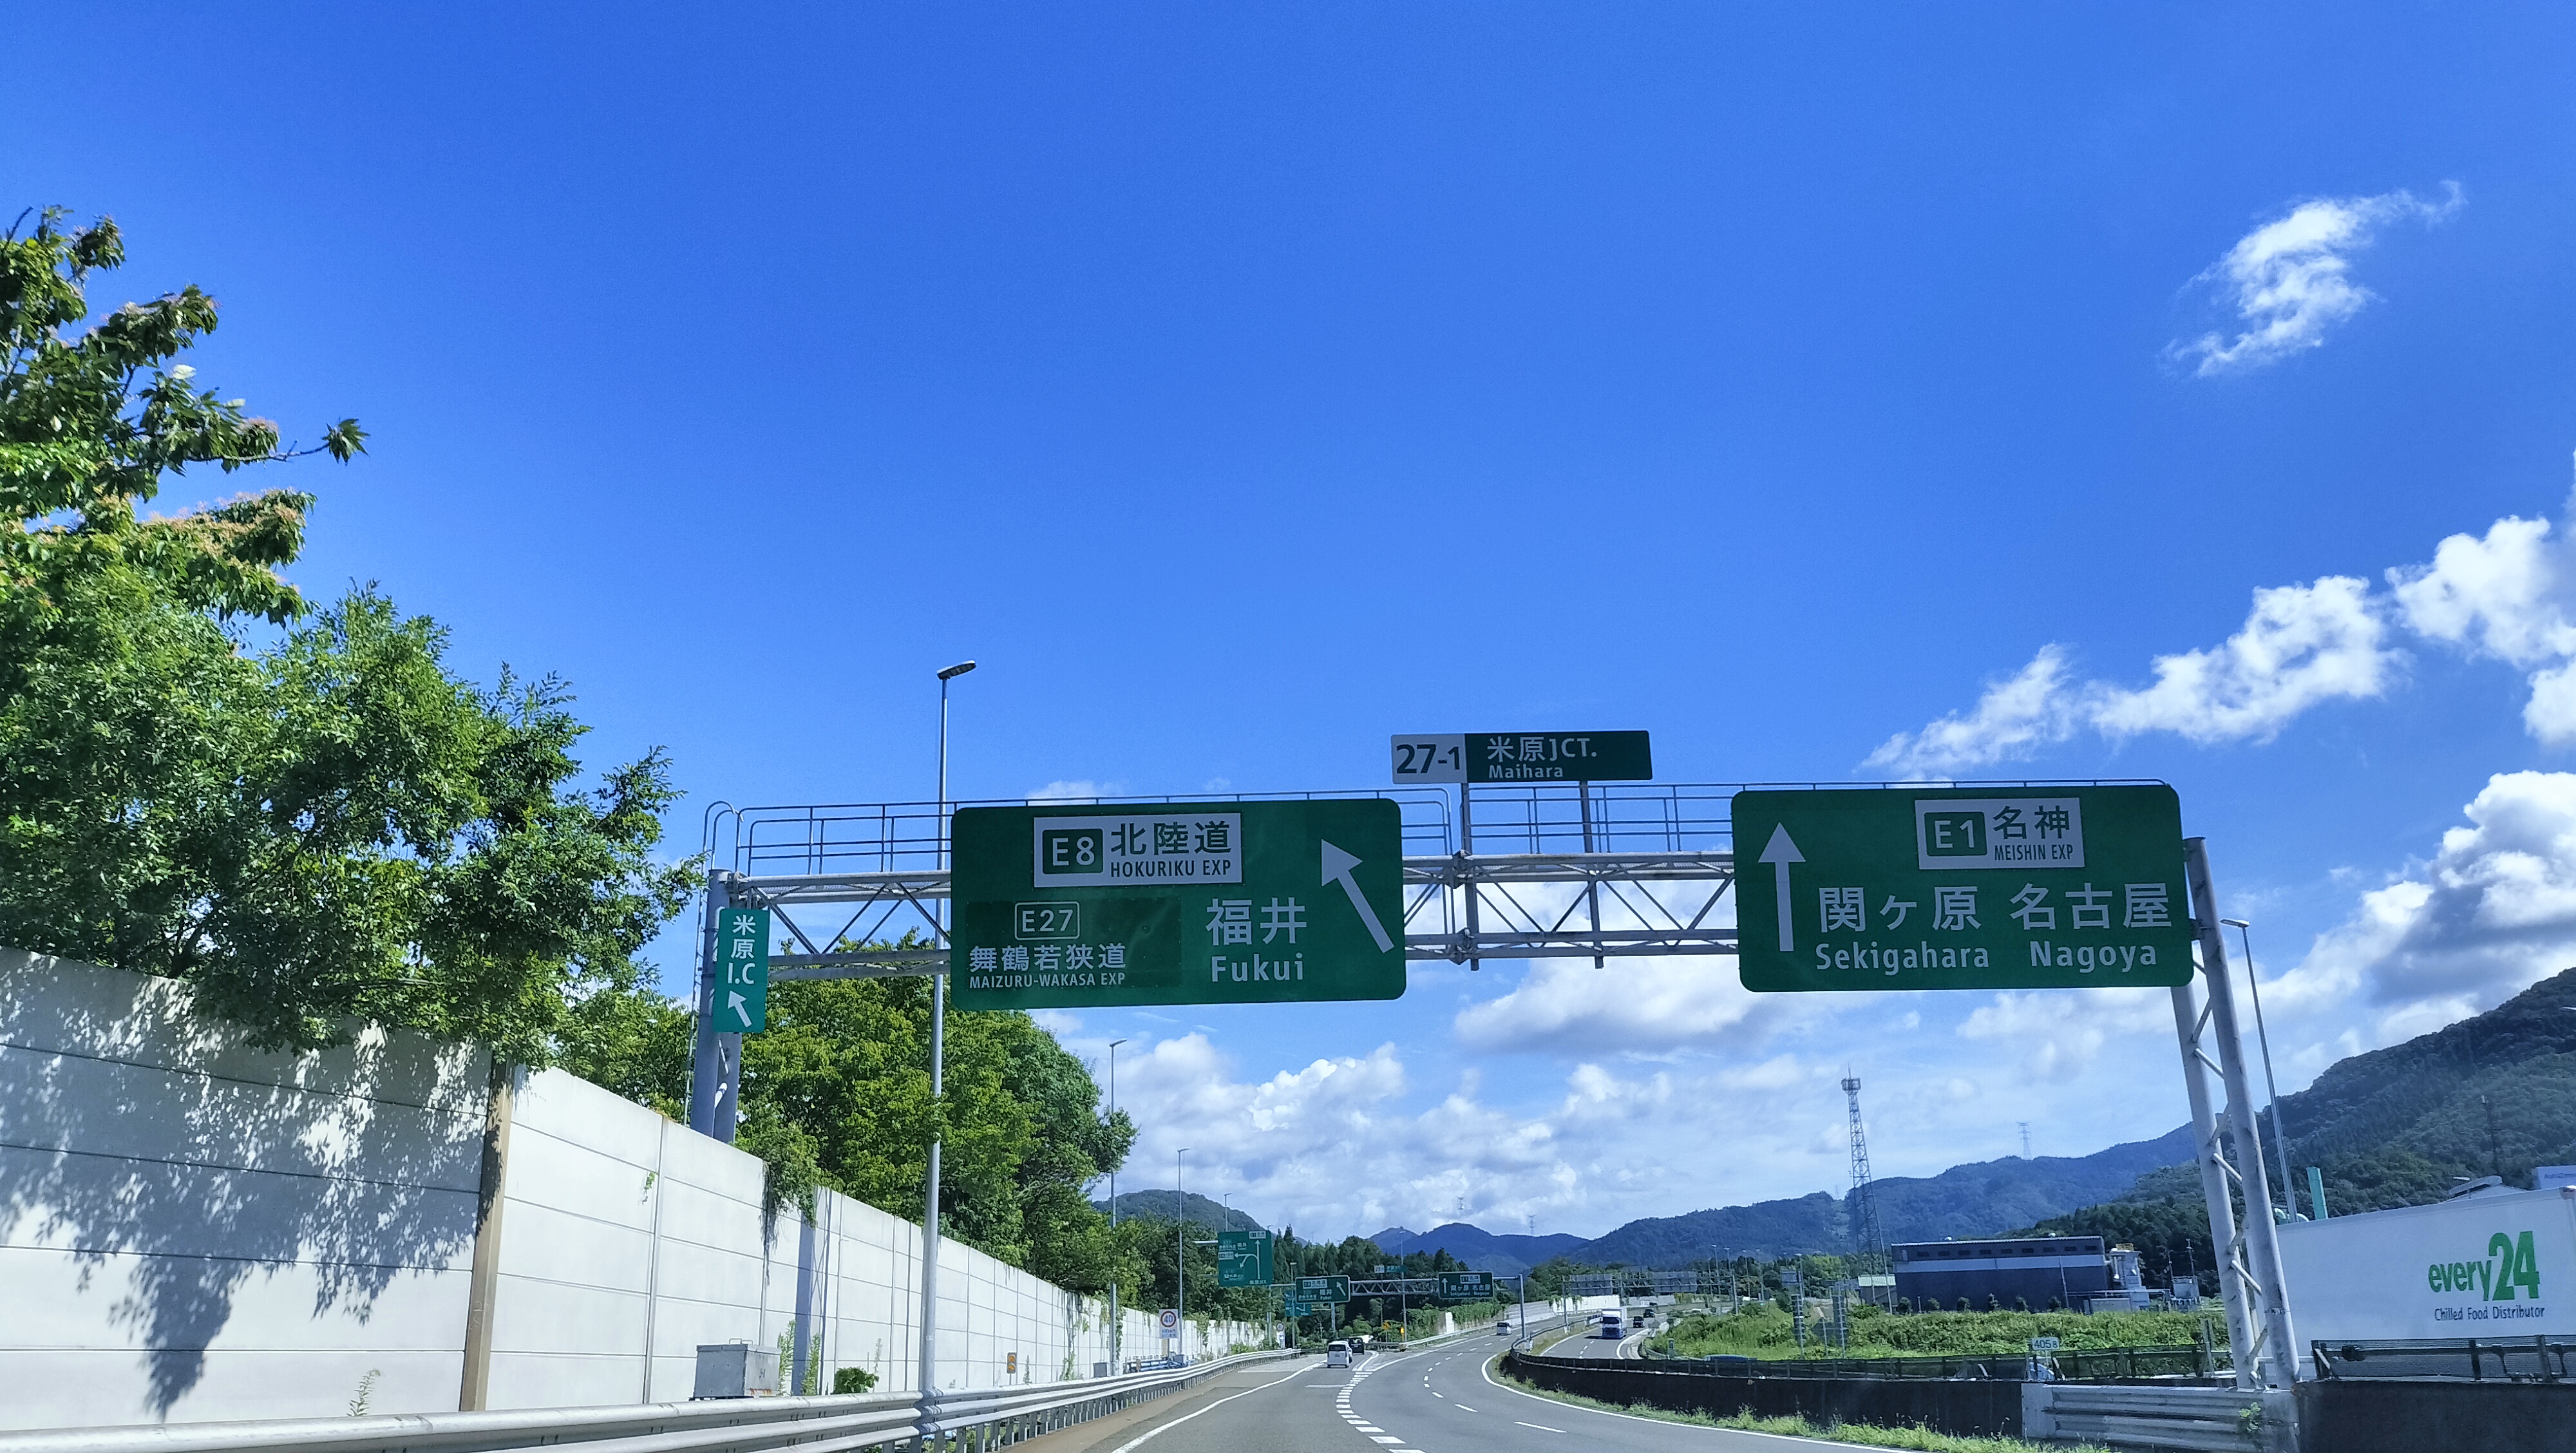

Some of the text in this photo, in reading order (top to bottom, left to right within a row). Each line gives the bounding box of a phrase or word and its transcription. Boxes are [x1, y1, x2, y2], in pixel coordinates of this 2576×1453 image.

[1396, 744, 1461, 774] 27-1
[1488, 764, 1564, 779] Maihara
[1935, 819, 1975, 850] E1
[1993, 805, 2070, 840] 名神
[1051, 835, 1097, 868] E8
[1110, 820, 1231, 857] 北陸道
[1994, 844, 2074, 861] MEISHIN EXP
[1110, 859, 1231, 879] HOKURIKU EXP
[1021, 907, 1073, 933] E27
[1206, 897, 1308, 946] 福井
[2009, 882, 2172, 931] 名古屋
[730, 914, 756, 959] 米原
[969, 942, 1127, 973] 舞鶴若狭道
[1211, 953, 1304, 982] Fukui
[1815, 940, 2157, 976] Sekigahara Nagoya
[969, 972, 1125, 989] MAIZURU-WAKASA EXP
[2434, 1304, 2545, 1321] Chilled Food Distributor
